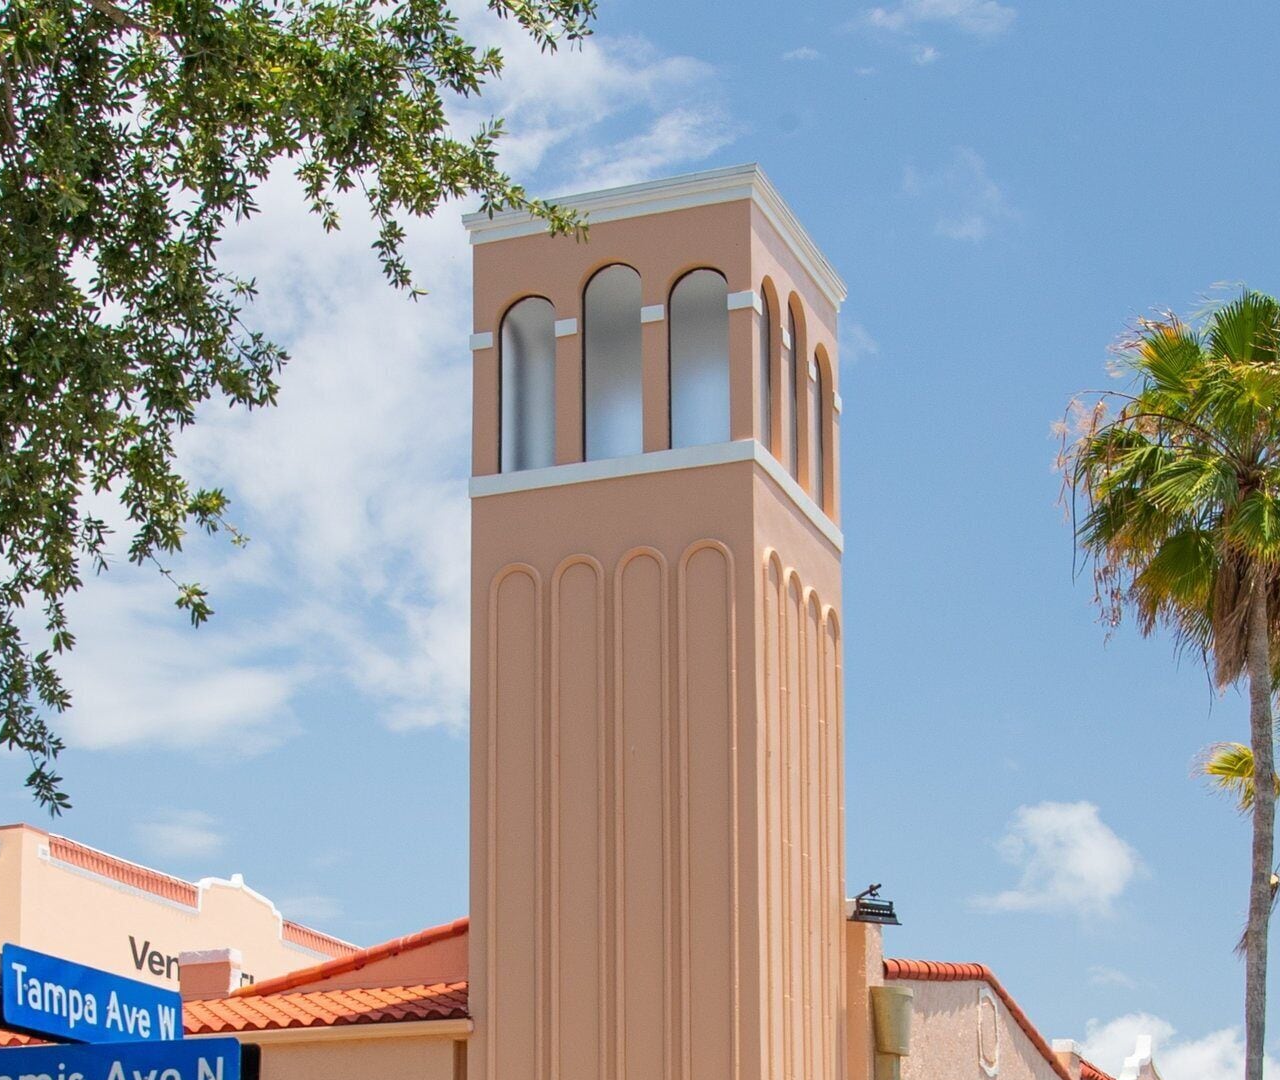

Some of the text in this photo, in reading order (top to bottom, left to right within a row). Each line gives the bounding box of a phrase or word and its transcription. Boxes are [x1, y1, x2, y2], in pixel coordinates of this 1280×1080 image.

[11, 962, 176, 1041] Tampa Ave W
